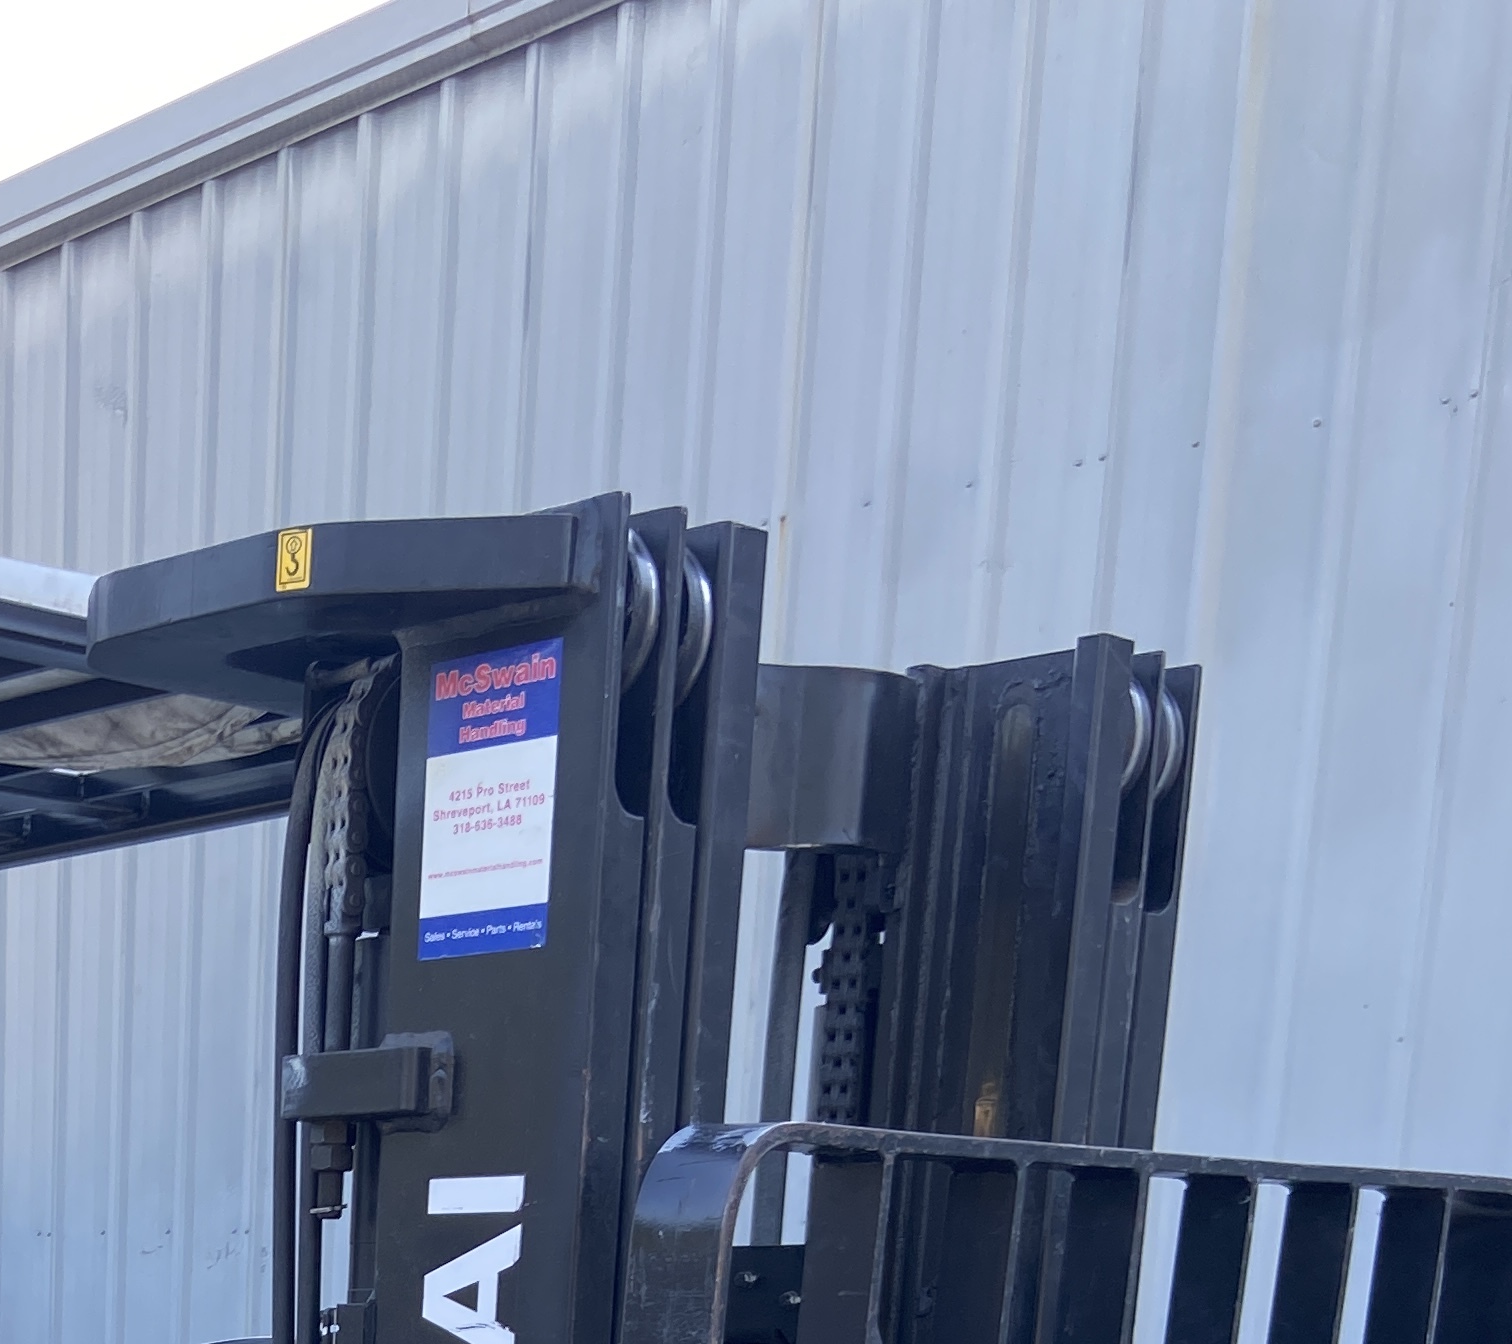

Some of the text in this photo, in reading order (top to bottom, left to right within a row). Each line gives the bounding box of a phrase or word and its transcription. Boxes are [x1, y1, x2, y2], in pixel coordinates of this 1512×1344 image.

[435, 652, 557, 701] McSwain
[462, 691, 526, 720] Material
[458, 718, 527, 745] Handling
[449, 779, 530, 802] 4215 Pro Street
[497, 798, 512, 811] LA
[515, 793, 545, 808] 71109
